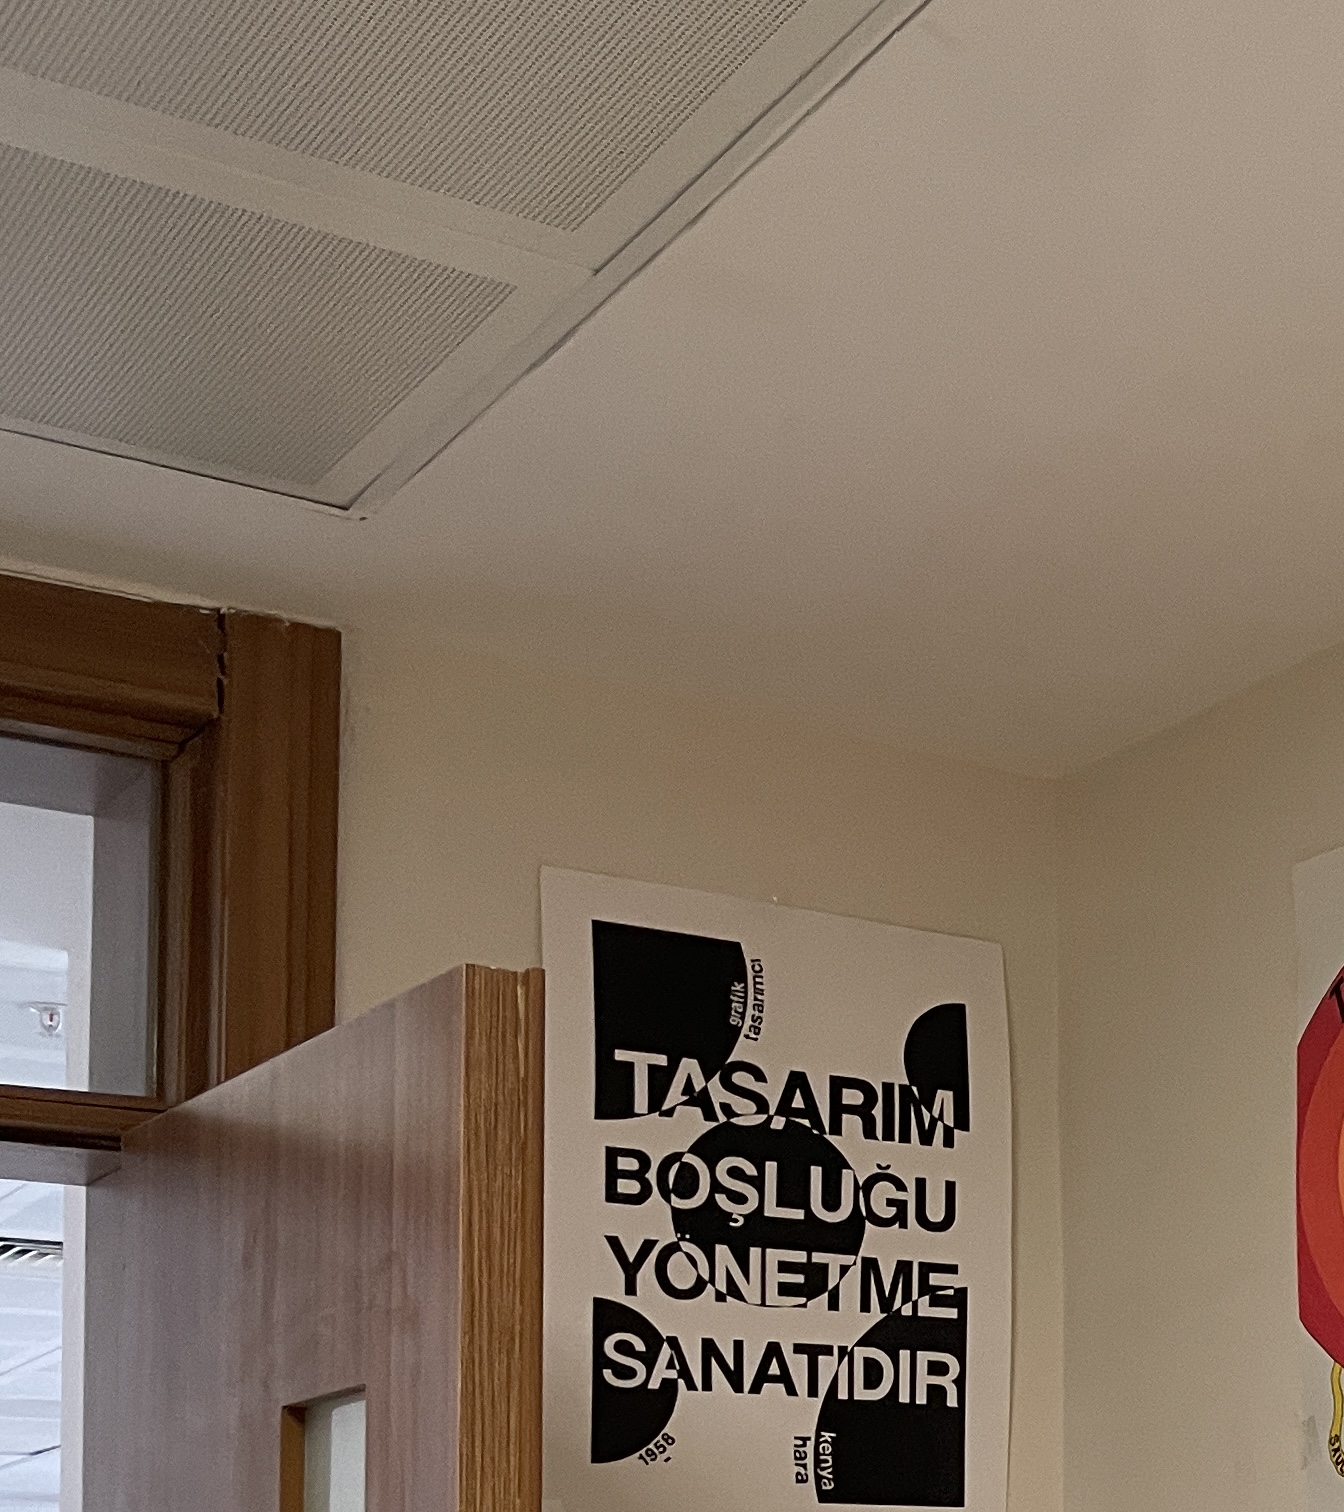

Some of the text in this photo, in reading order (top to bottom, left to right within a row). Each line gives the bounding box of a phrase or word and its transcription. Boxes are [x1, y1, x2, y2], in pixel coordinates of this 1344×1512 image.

[729, 981, 745, 1027] grafik
[743, 958, 765, 1041] tasarımcı
[612, 1048, 956, 1150] TASARIM
[604, 1145, 958, 1233] BOŞLUĞU
[604, 1232, 961, 1320] YÖNETME
[601, 1331, 961, 1408] SANATIDIR
[793, 1435, 812, 1485] hara
[816, 1431, 837, 1491] kenya
